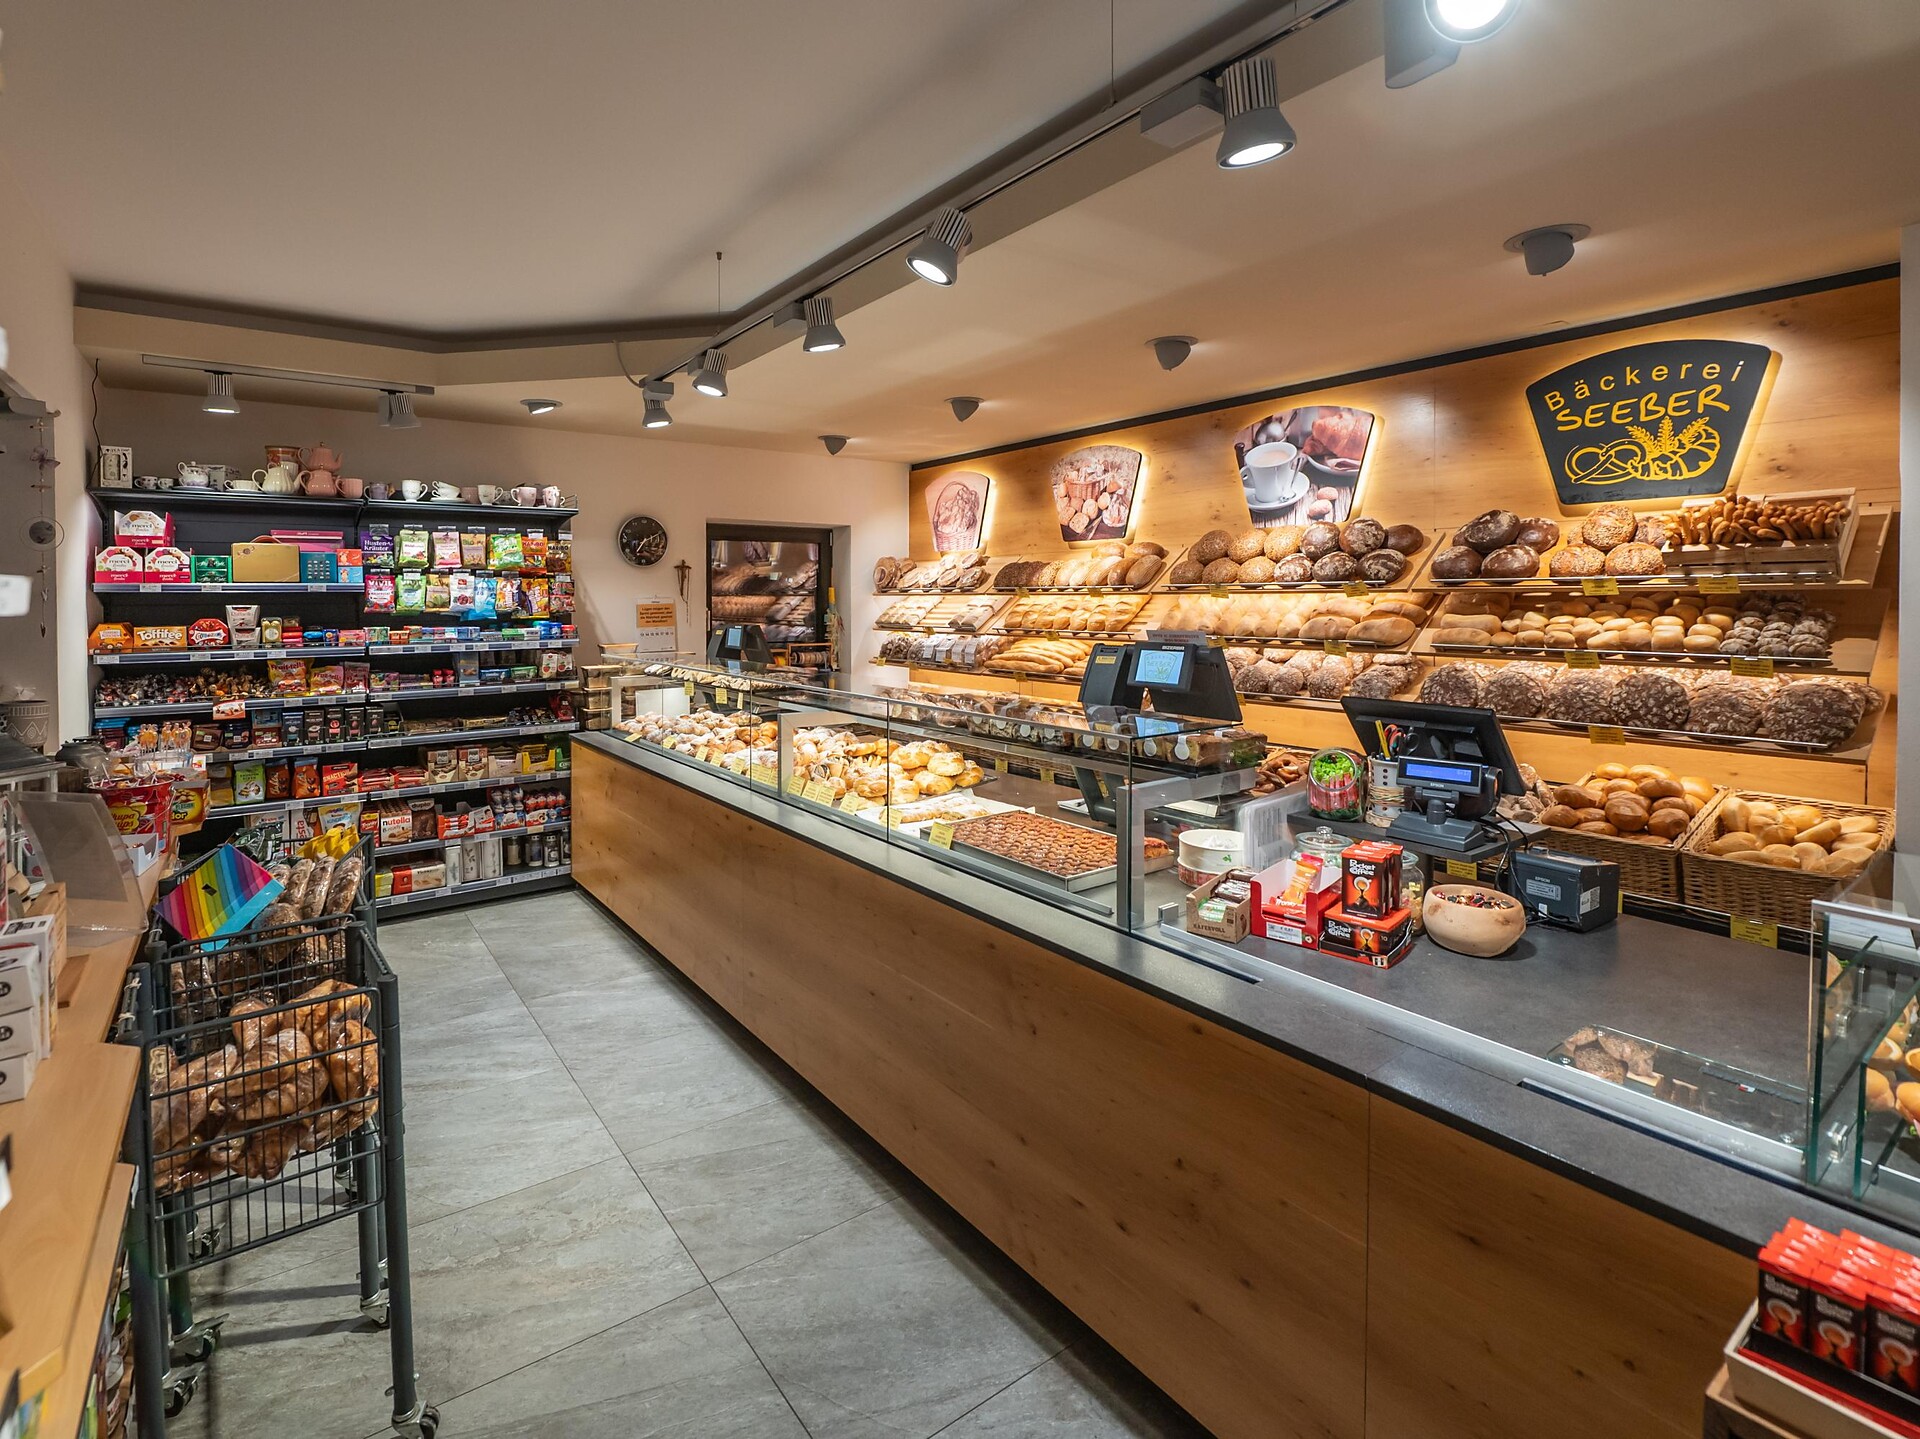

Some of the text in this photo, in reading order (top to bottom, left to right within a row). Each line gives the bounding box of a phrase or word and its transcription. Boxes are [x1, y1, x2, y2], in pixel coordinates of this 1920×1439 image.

[1544, 360, 1745, 412] Bäckerei
[1556, 384, 1731, 432] SEEBER
[136, 629, 183, 641] Toffifee
[382, 816, 411, 827] nutella
[1349, 859, 1376, 871] Pocket
[1349, 866, 1375, 876] Coffee
[1328, 920, 1352, 934] Pocket
[1328, 927, 1351, 939] Coffee
